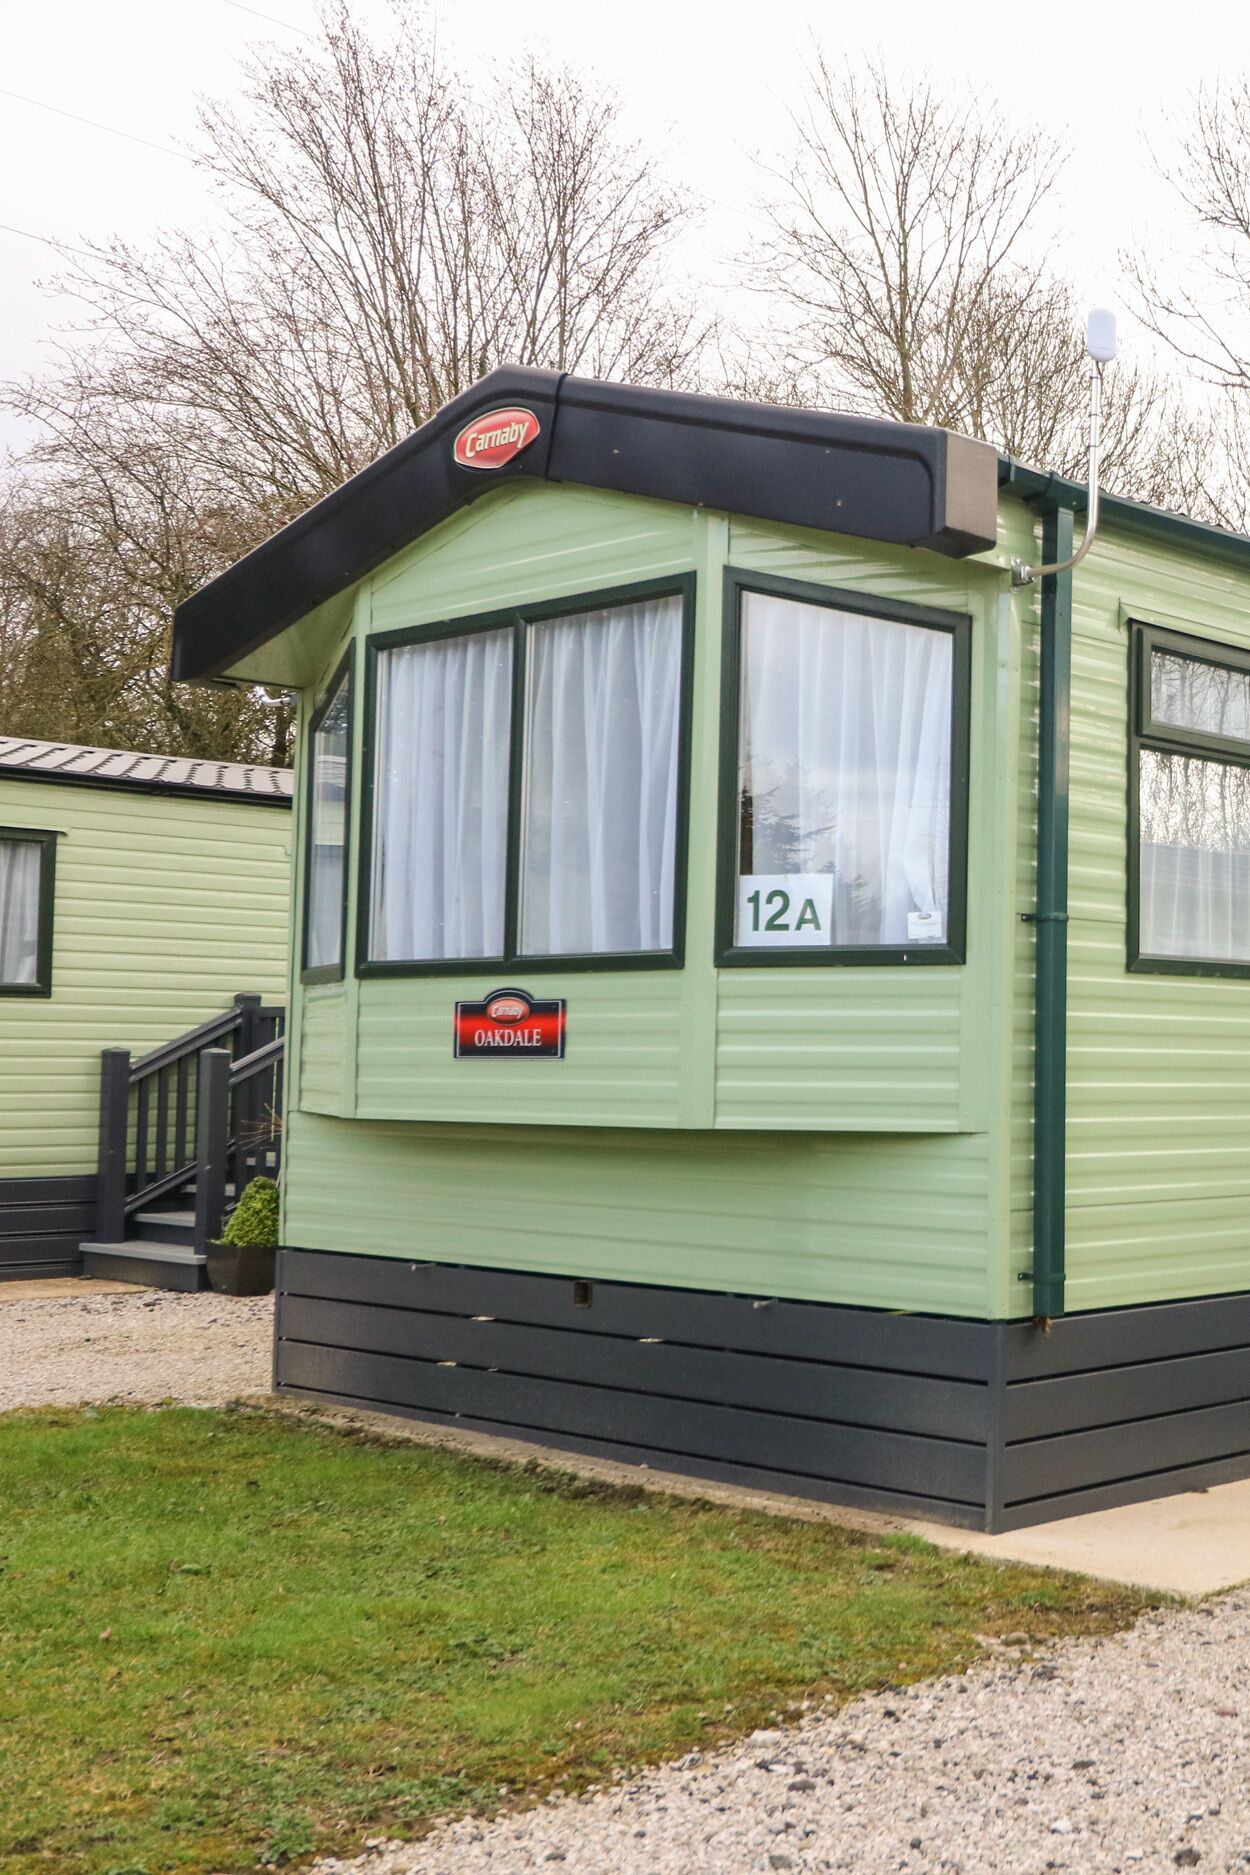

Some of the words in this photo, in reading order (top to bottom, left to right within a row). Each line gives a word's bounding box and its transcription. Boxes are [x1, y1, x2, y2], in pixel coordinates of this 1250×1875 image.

[465, 421, 529, 458] Carnaby
[746, 889, 822, 932] 12A
[491, 1005, 524, 1019] Carnaby
[474, 1029, 542, 1047] OAKDALE
